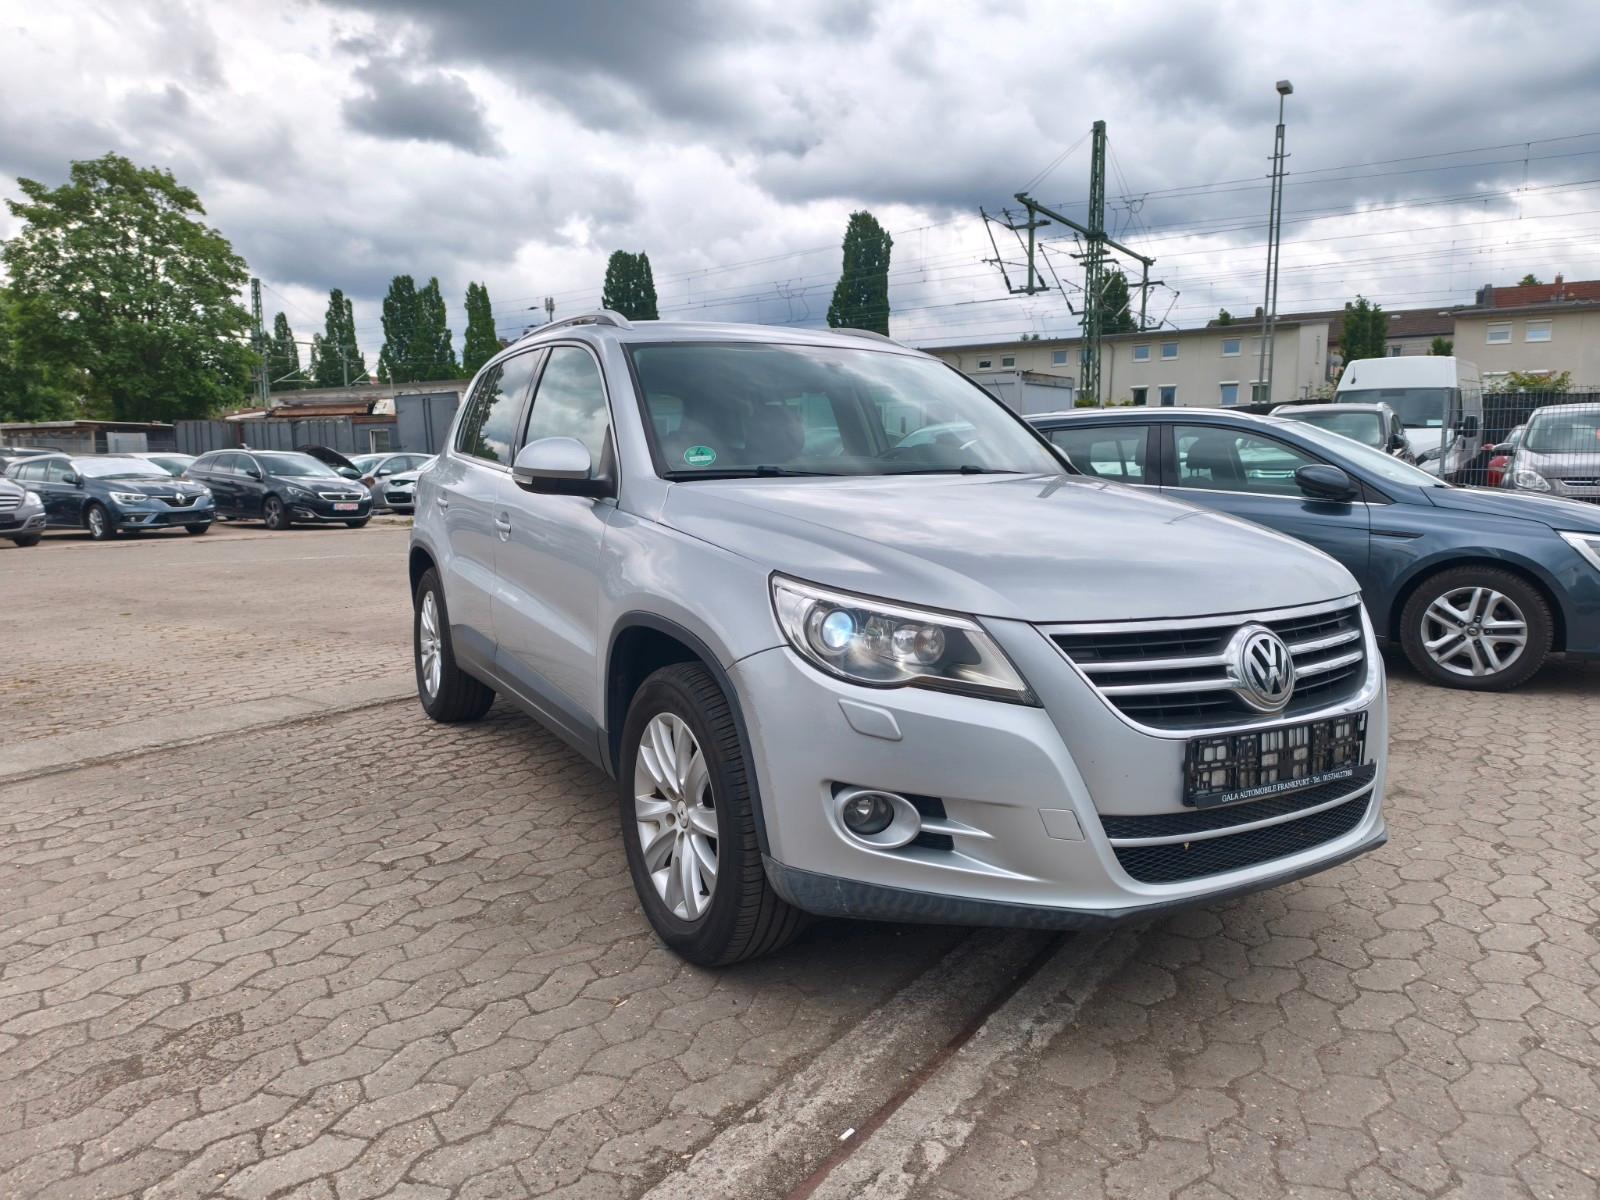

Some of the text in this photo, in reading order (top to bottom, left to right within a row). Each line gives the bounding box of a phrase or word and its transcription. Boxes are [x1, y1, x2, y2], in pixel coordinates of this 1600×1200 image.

[695, 447, 705, 456] 4
[1244, 633, 1291, 701] VW
[1222, 793, 1239, 803] GALA
[1240, 784, 1277, 799] AUTOMOBILE
[1277, 778, 1310, 791] FRANKFURT
